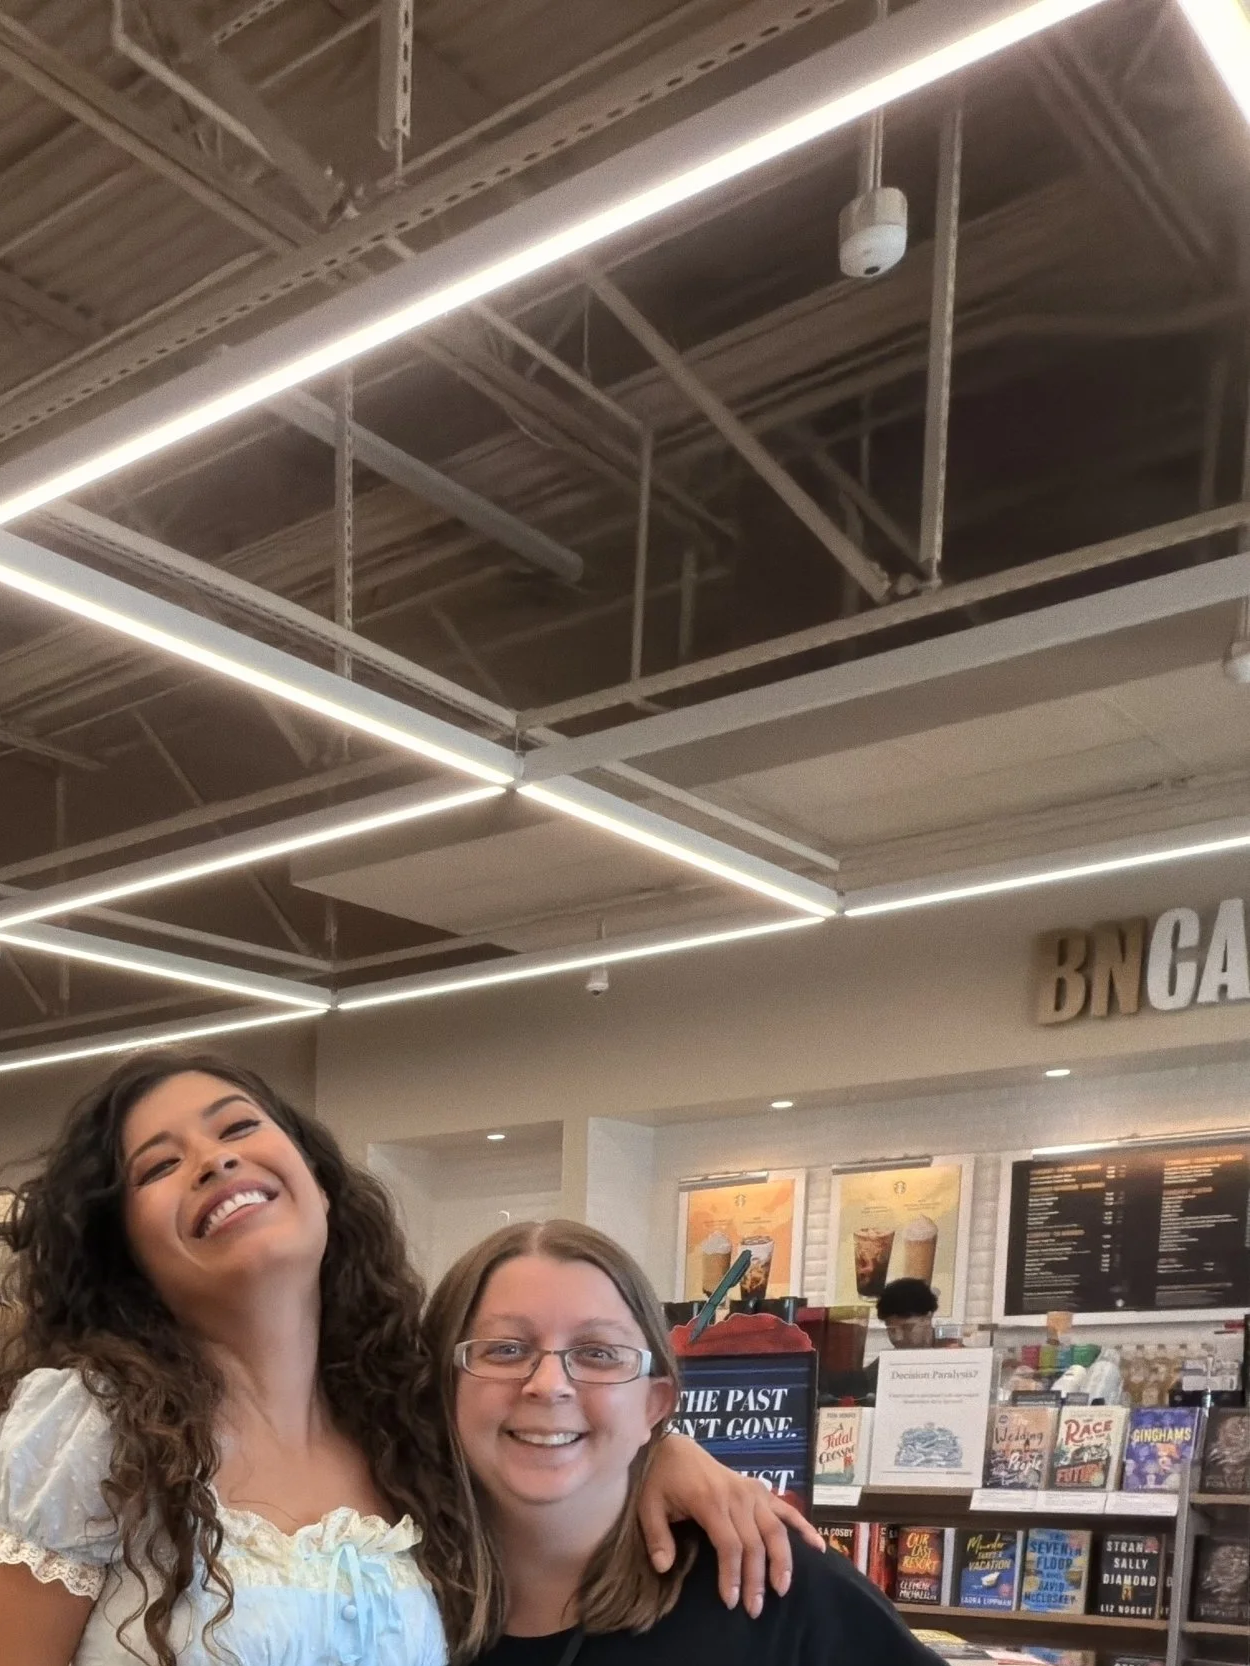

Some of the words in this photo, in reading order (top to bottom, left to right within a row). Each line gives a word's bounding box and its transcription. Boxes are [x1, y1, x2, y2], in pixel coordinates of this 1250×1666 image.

[891, 1370, 930, 1380] Decision
[932, 1370, 979, 1380] Paralysis?
[675, 1389, 721, 1413] THE
[725, 1388, 788, 1412] PAST
[726, 1416, 797, 1441] GONE.
[1064, 1418, 1114, 1446] RACE
[830, 1527, 854, 1538] COSBY
[905, 1532, 930, 1549] OUR
[1106, 1540, 1158, 1554] STRAN
[911, 1545, 933, 1558] LAST
[901, 1556, 941, 1571] RESORT
[968, 1559, 1011, 1571] VACATION
[1035, 1555, 1073, 1570] FLOOR
[1113, 1557, 1149, 1570] SALLY
[1102, 1573, 1157, 1587] DIAMOND
[1100, 1604, 1114, 1613] LIZ
[1118, 1605, 1153, 1615] NUGENT
